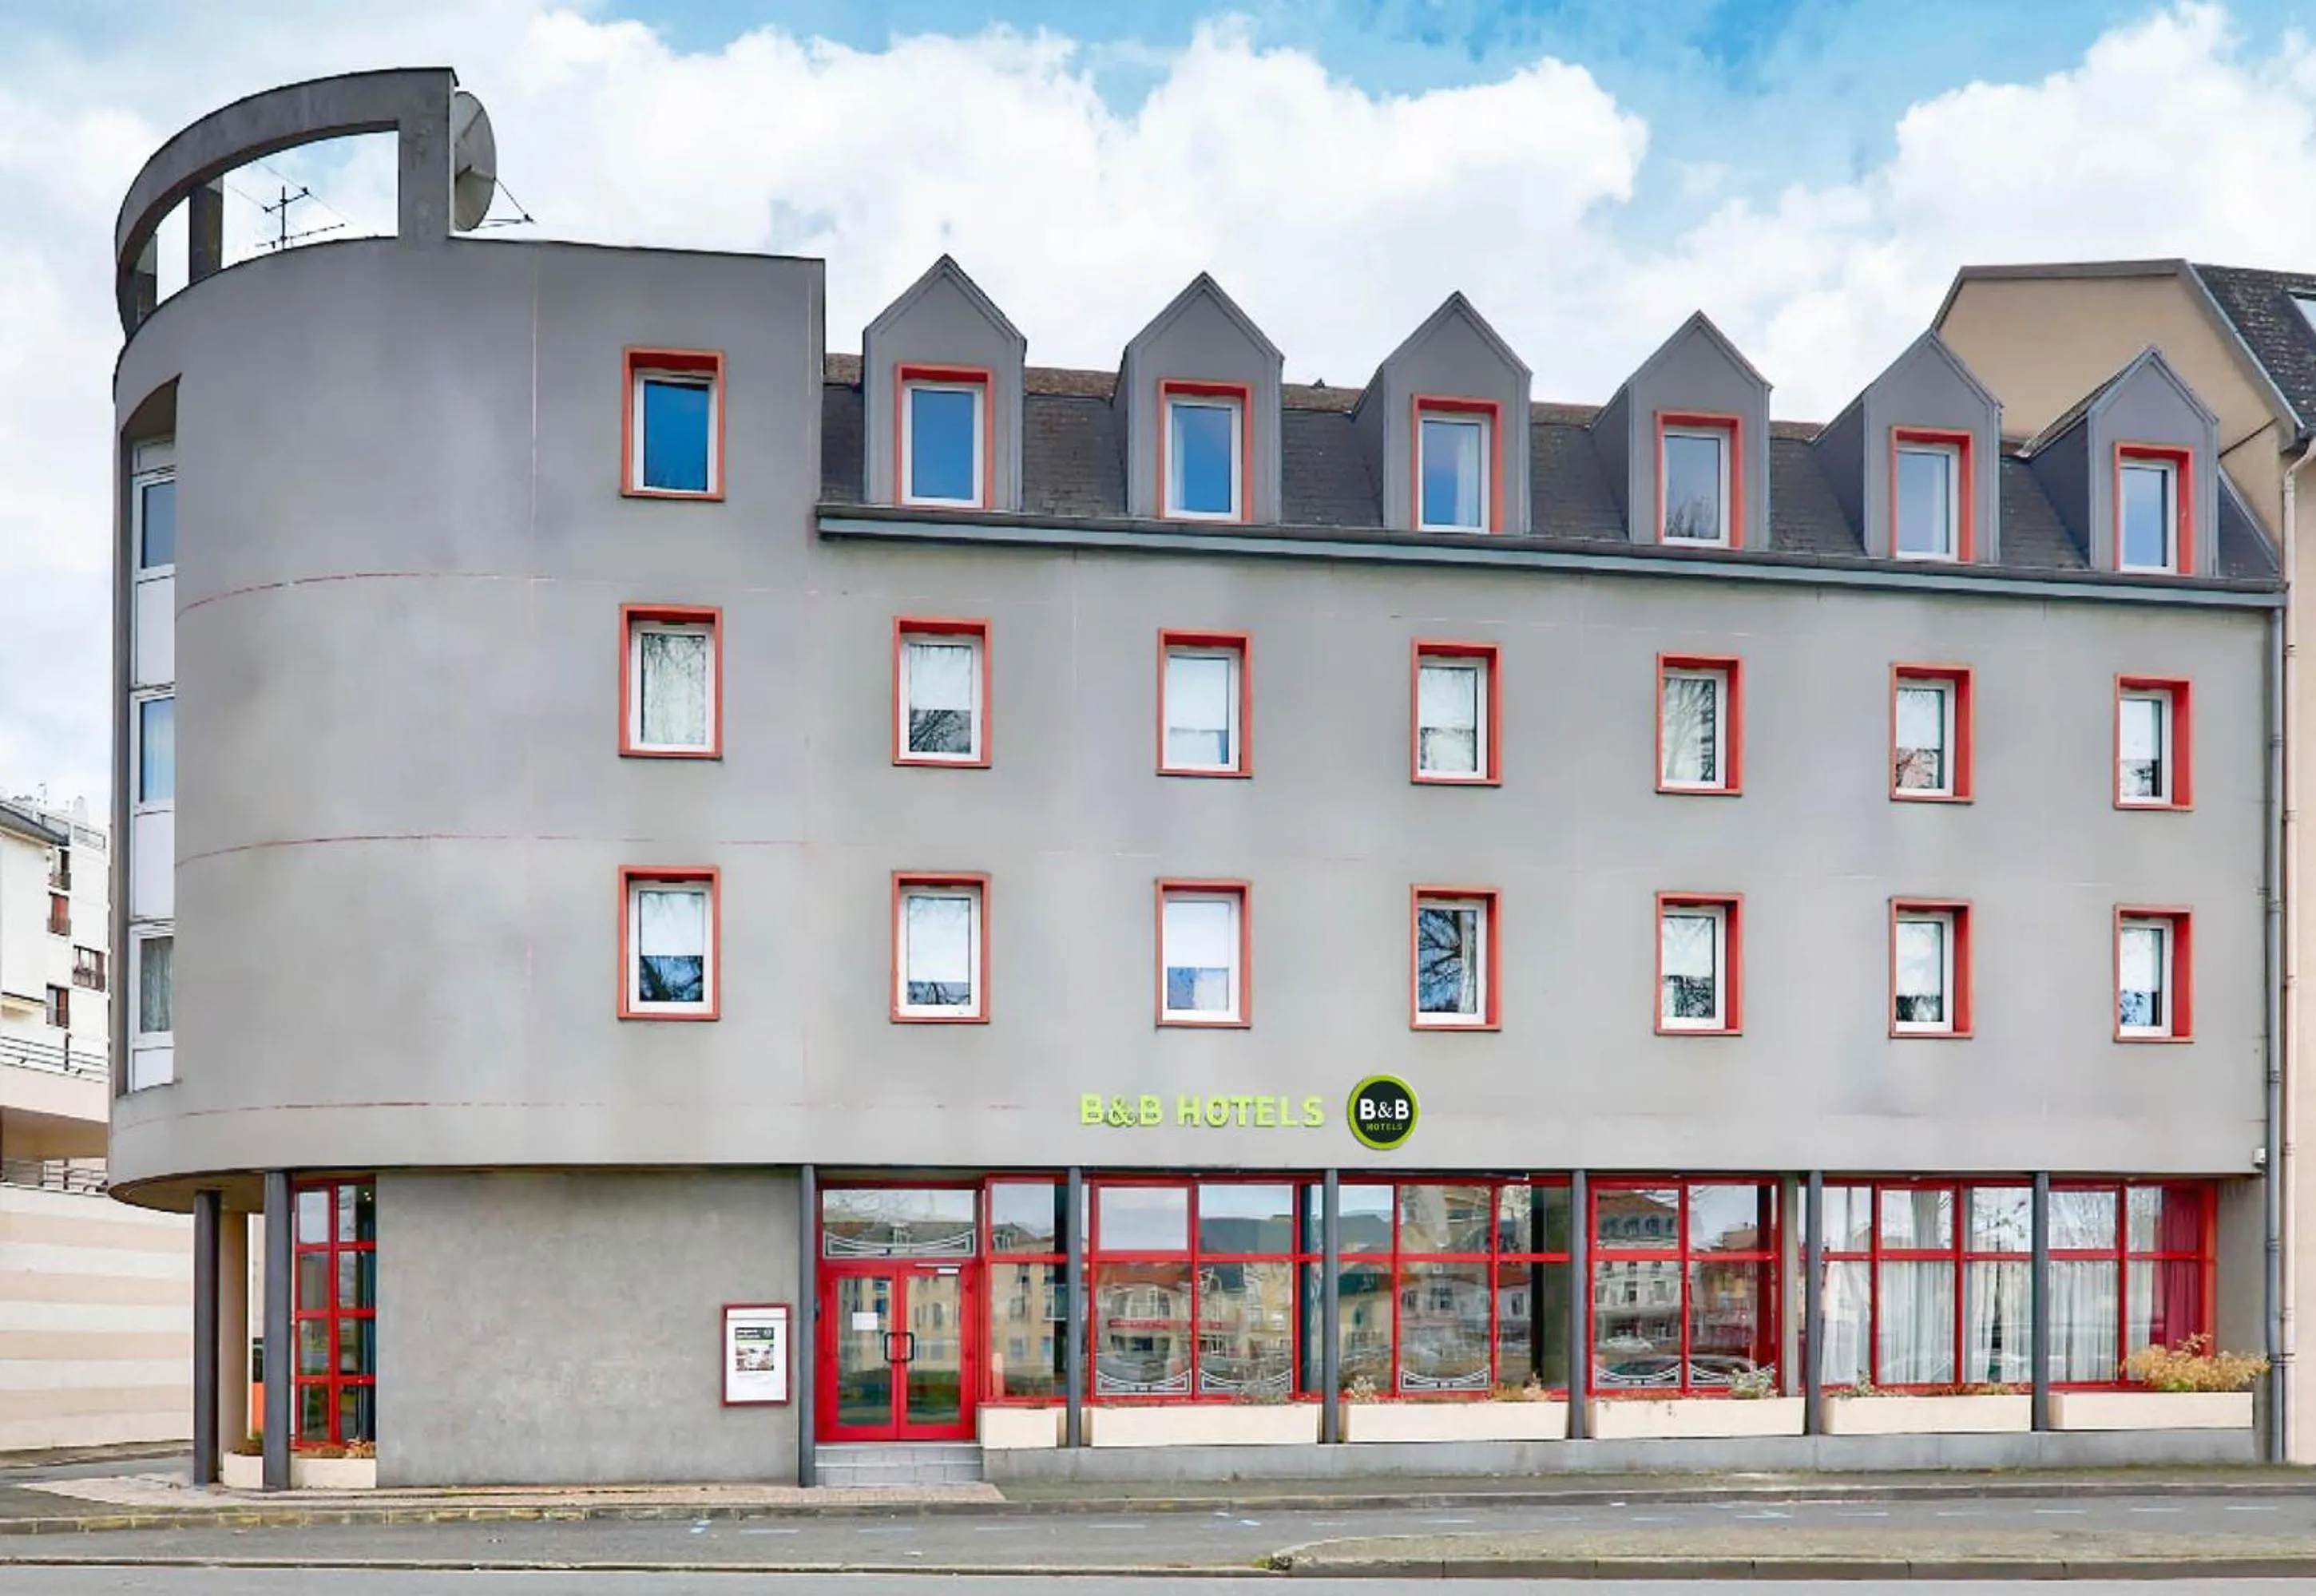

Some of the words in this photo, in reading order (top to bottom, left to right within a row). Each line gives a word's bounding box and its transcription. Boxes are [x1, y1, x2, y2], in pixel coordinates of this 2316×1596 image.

[1081, 1093, 1161, 1127] B&B
[1176, 1094, 1324, 1127] HOTELS
[1359, 1098, 1410, 1119] B&B
[1366, 1123, 1403, 1131] HOTELS
